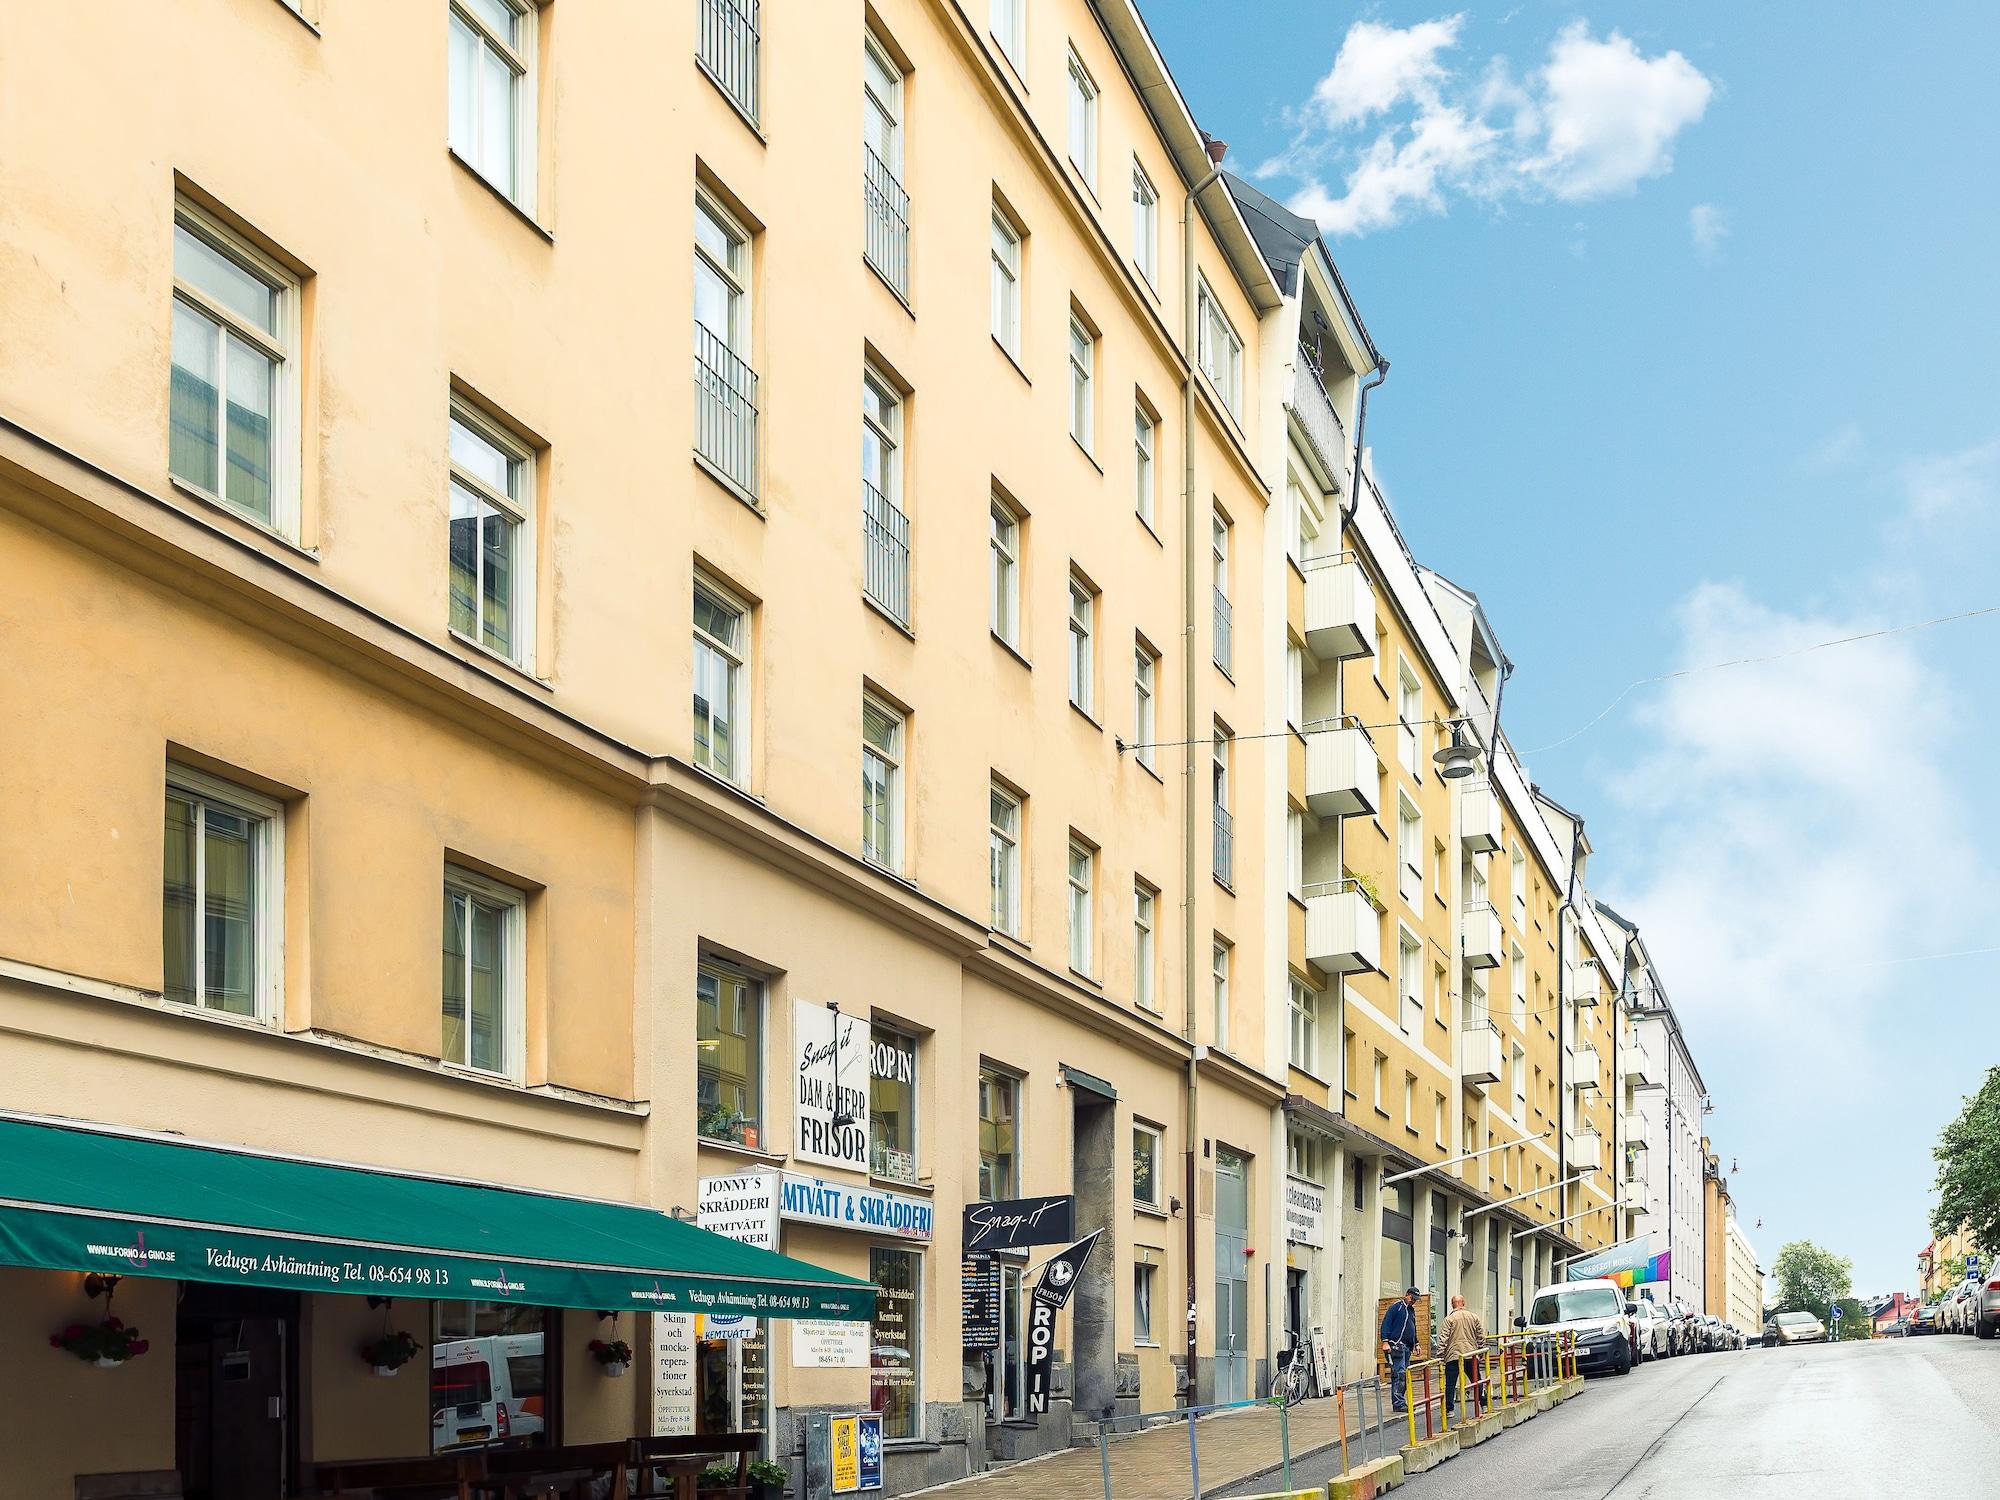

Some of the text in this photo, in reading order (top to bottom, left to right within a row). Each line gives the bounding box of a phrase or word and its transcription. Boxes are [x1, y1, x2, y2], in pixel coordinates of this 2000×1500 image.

[869, 1040, 913, 1085] ROP IN
[800, 1075, 865, 1120] DAM & HERR
[699, 1196, 769, 1215] SKRÄDDERI
[781, 1179, 932, 1232] MTVÄTT & SKRÄDDERI
[704, 1218, 766, 1232] KEMTVÄTT
[148, 1250, 176, 1262] GINO.SE
[206, 1248, 449, 1286] Vedugn Avhämtning Tel. 08-654 98 13
[688, 1289, 810, 1310] Vedugn Avhämtning Tel. 08-654 98 13
[889, 1287, 915, 1300] Skrädderi
[663, 1313, 687, 1324] Skinn
[667, 1328, 683, 1338] och
[875, 1328, 907, 1341] Syverkstad
[660, 1342, 690, 1352] mocka-
[660, 1358, 689, 1368] repera-
[662, 1371, 687, 1380] tioner
[656, 1386, 693, 1399] Syverkstad
